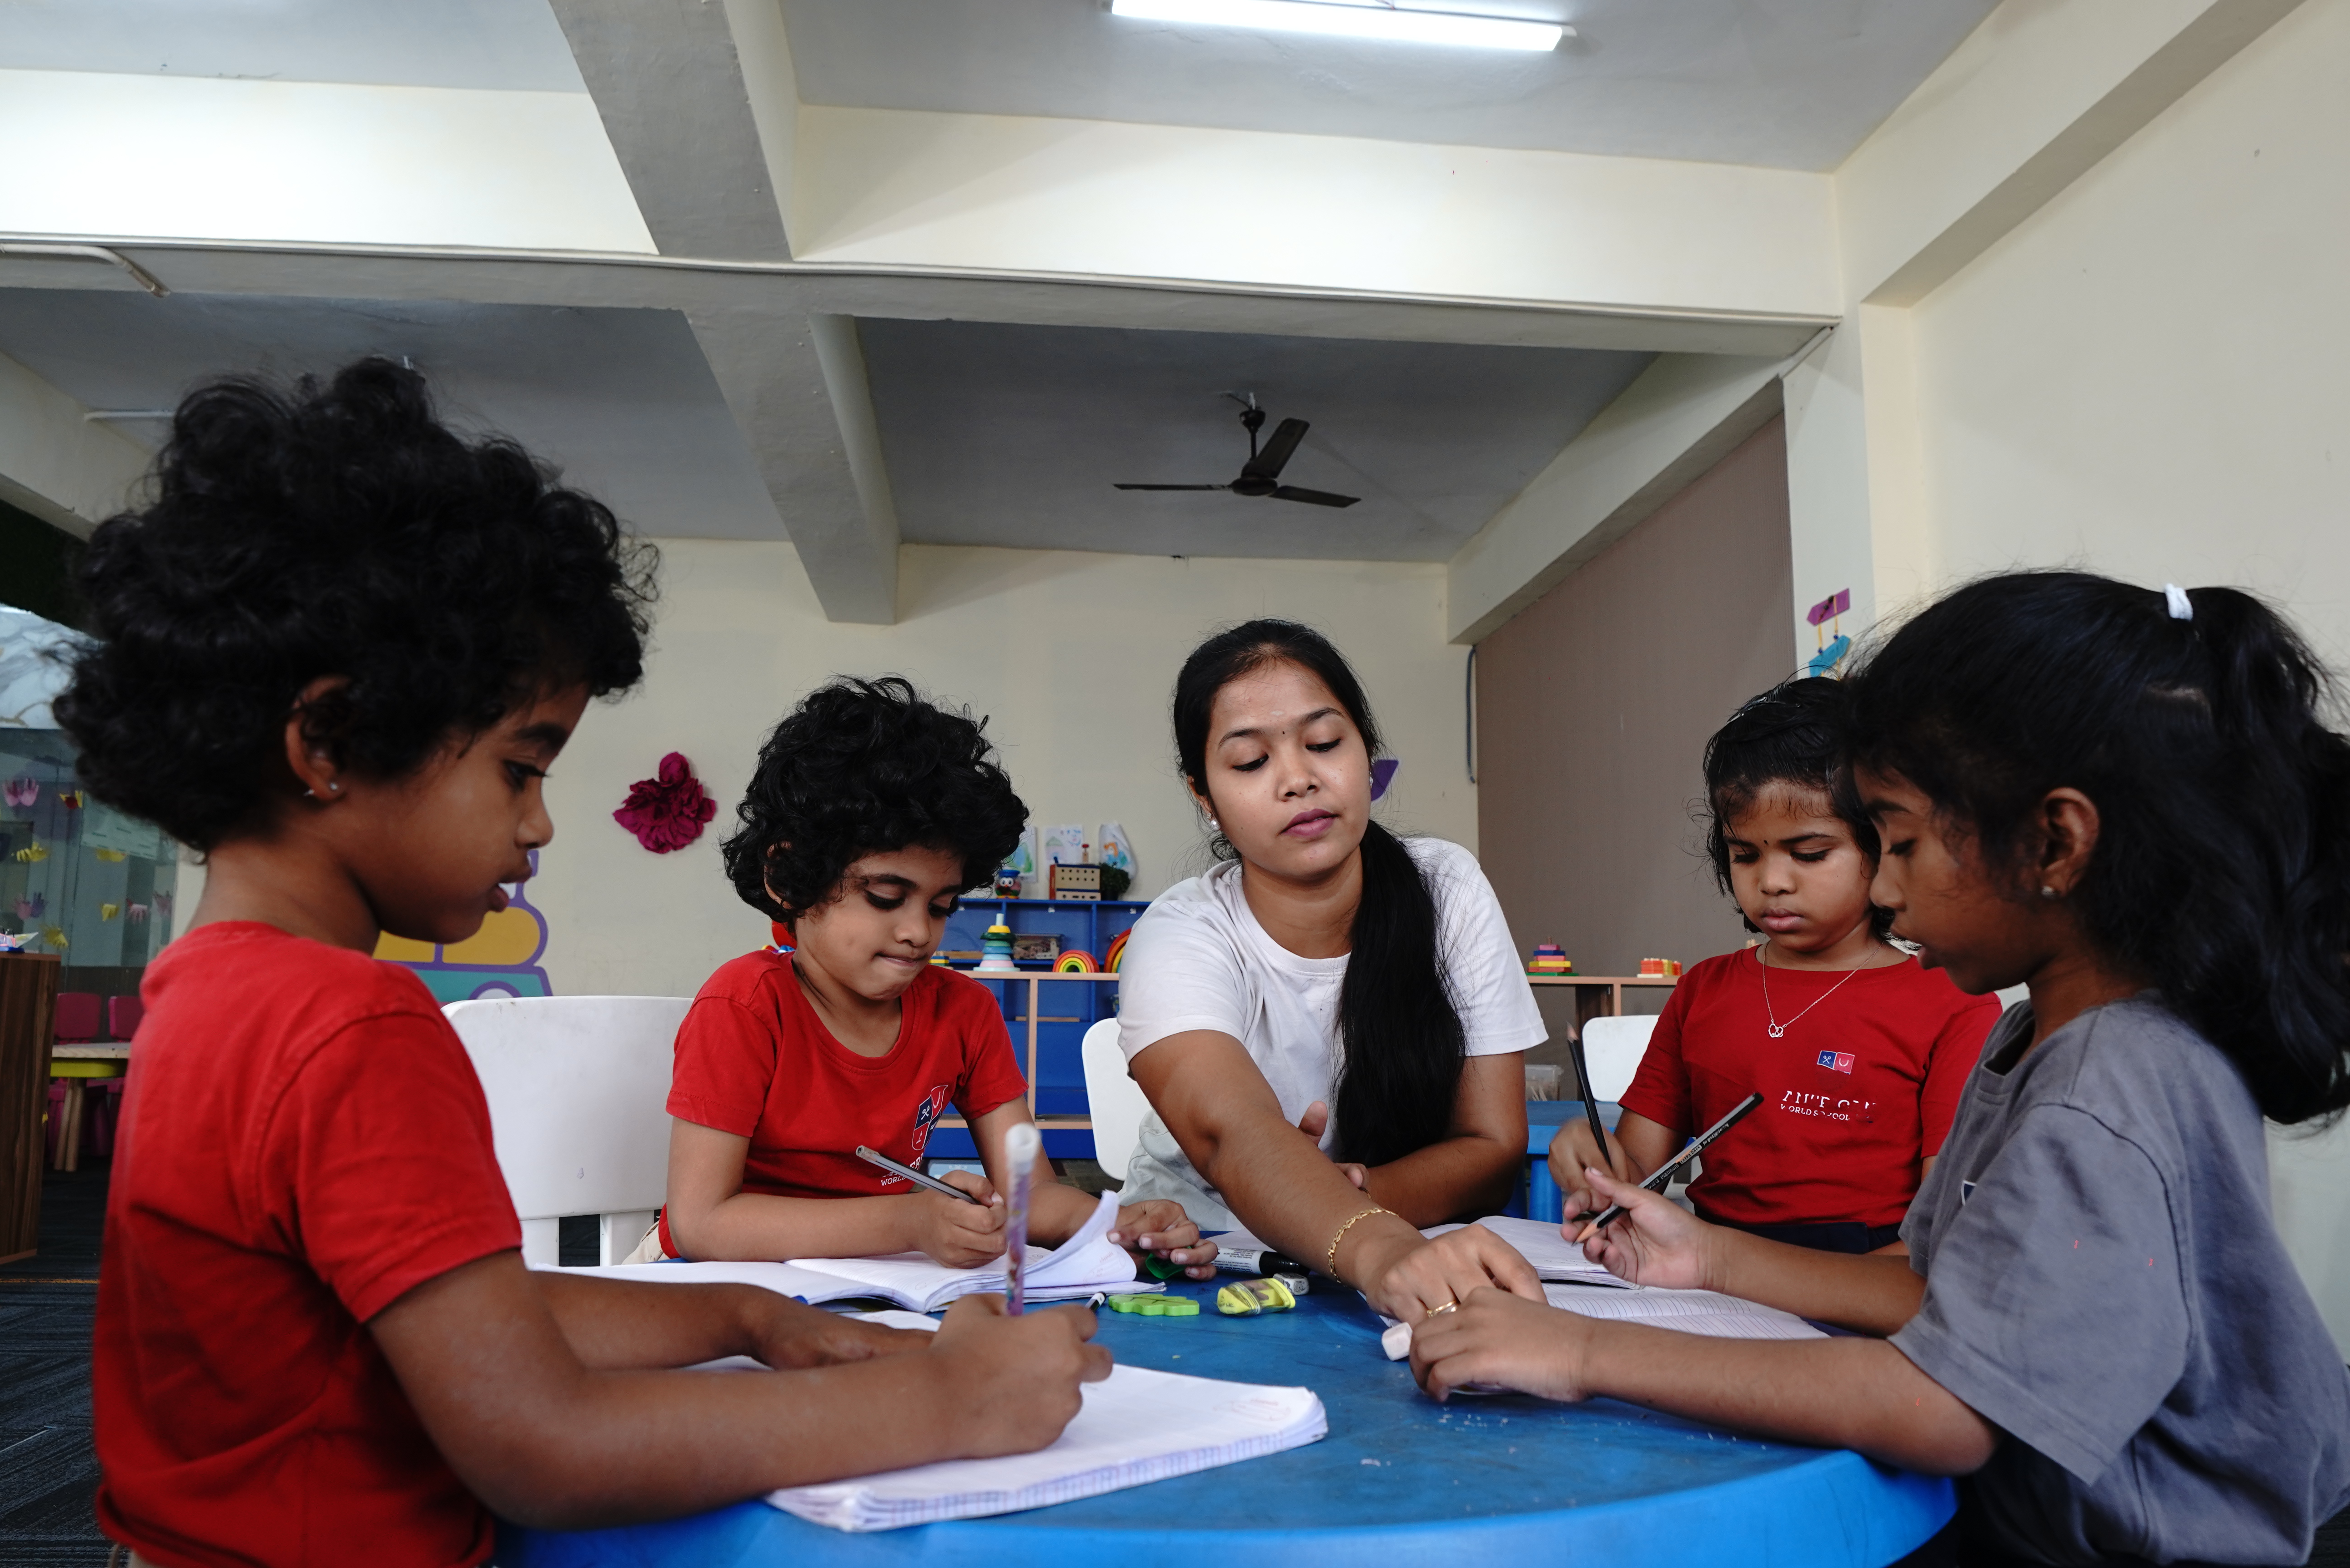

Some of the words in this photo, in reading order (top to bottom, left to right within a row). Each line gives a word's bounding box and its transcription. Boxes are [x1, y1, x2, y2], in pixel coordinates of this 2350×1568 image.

[1813, 1110, 1850, 1121] SOOL
[1660, 1164, 1679, 1180] Platinum
[1691, 1146, 1701, 1154] DARK
